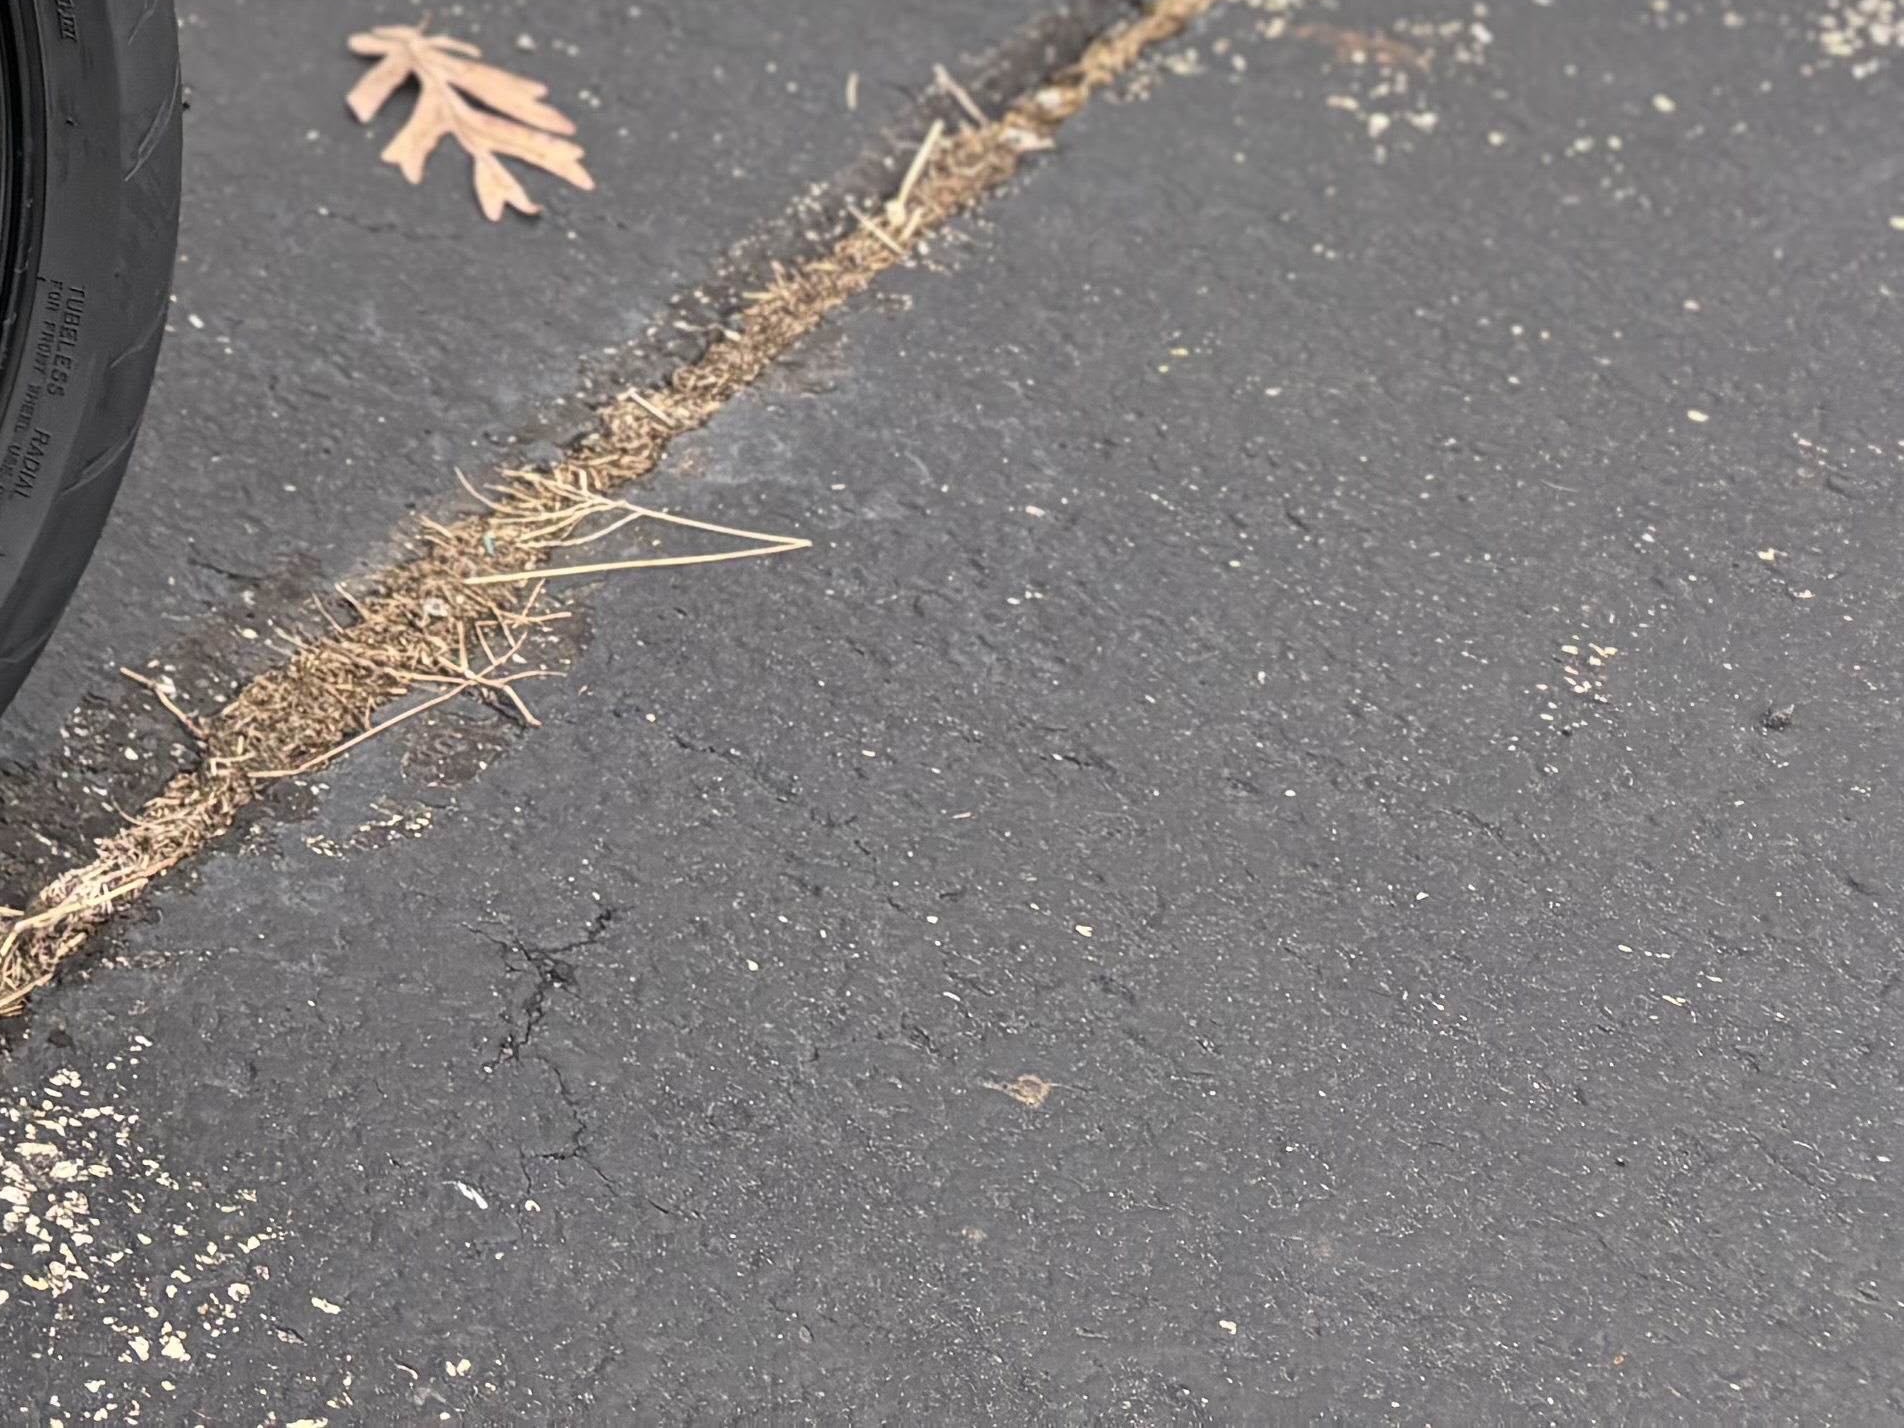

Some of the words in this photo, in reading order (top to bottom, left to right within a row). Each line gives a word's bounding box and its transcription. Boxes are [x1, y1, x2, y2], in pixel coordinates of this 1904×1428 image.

[47, 280, 65, 313] FOR
[35, 319, 57, 374] FRONT
[48, 286, 86, 397] TUBELESS
[17, 429, 52, 499] RADIAL
